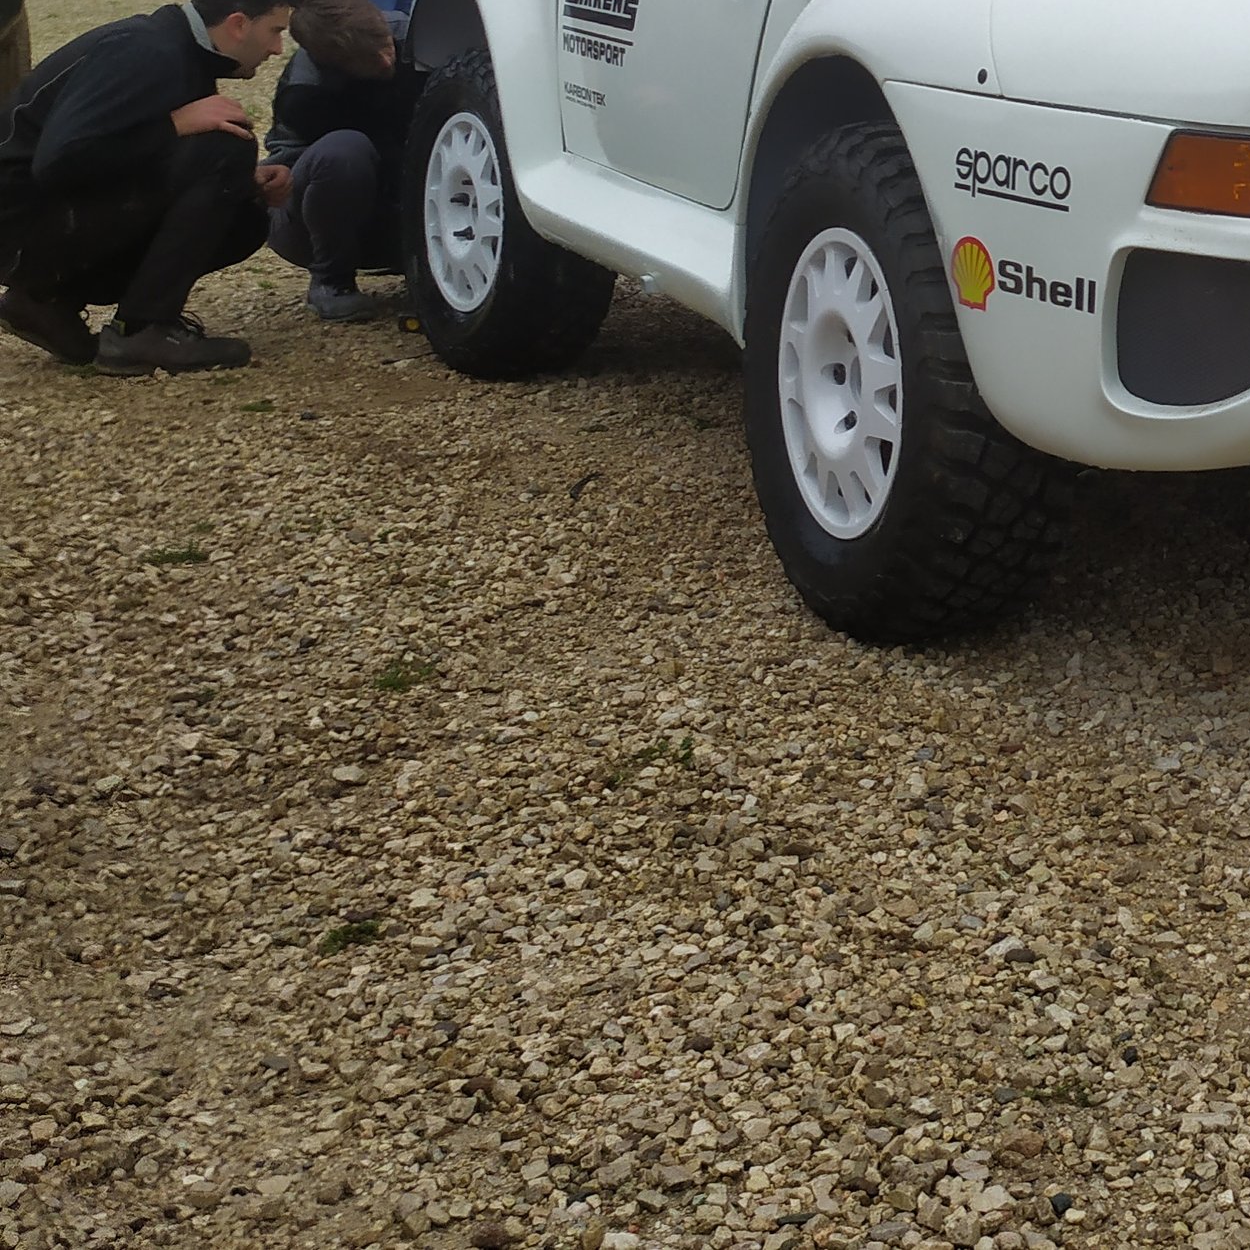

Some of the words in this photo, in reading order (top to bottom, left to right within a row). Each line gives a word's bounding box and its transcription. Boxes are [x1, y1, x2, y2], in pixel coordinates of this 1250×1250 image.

[563, 33, 626, 67] MOTORSPORT
[955, 147, 1071, 200] sparco
[998, 259, 1096, 314] Shell
